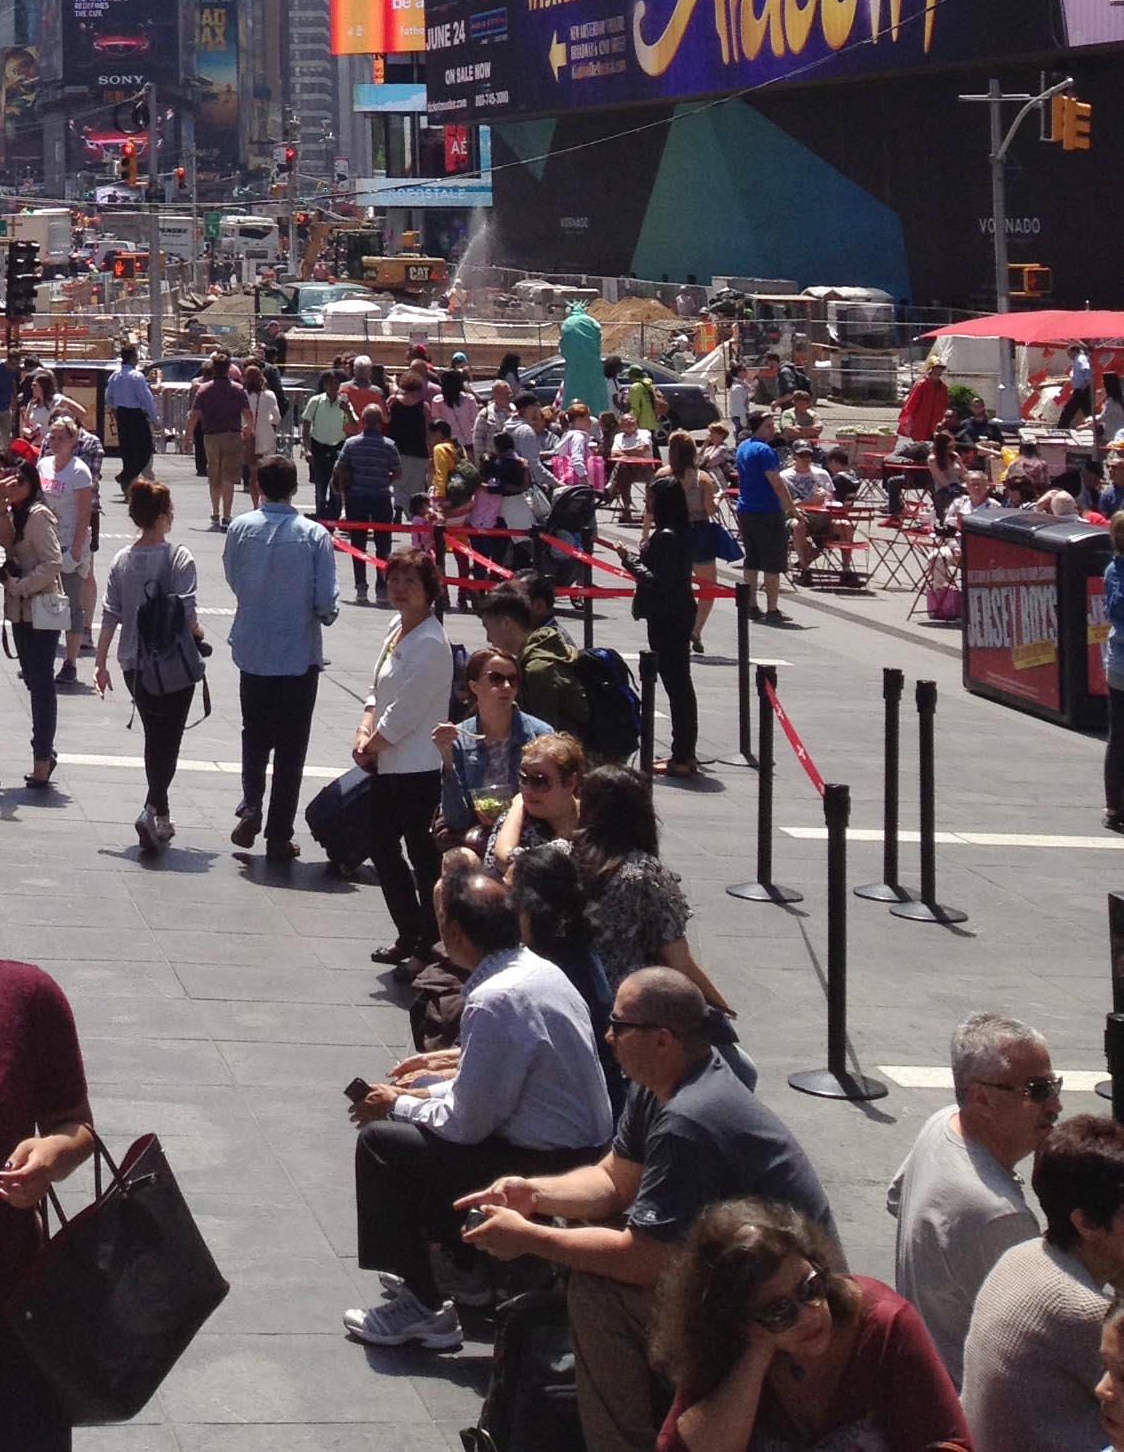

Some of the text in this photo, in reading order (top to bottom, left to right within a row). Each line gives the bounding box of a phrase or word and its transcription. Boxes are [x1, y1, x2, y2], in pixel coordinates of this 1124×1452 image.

[426, 23, 452, 52] JUNE
[453, 19, 467, 46] 24
[98, 75, 144, 85] SONY
[444, 60, 492, 85] ON SALE NOW
[450, 136, 469, 156] AÉ
[978, 217, 1041, 234] VONADO
[409, 266, 429, 281] CAT
[967, 585, 1018, 649] JERSEY
[1018, 582, 1059, 648] BOYS
